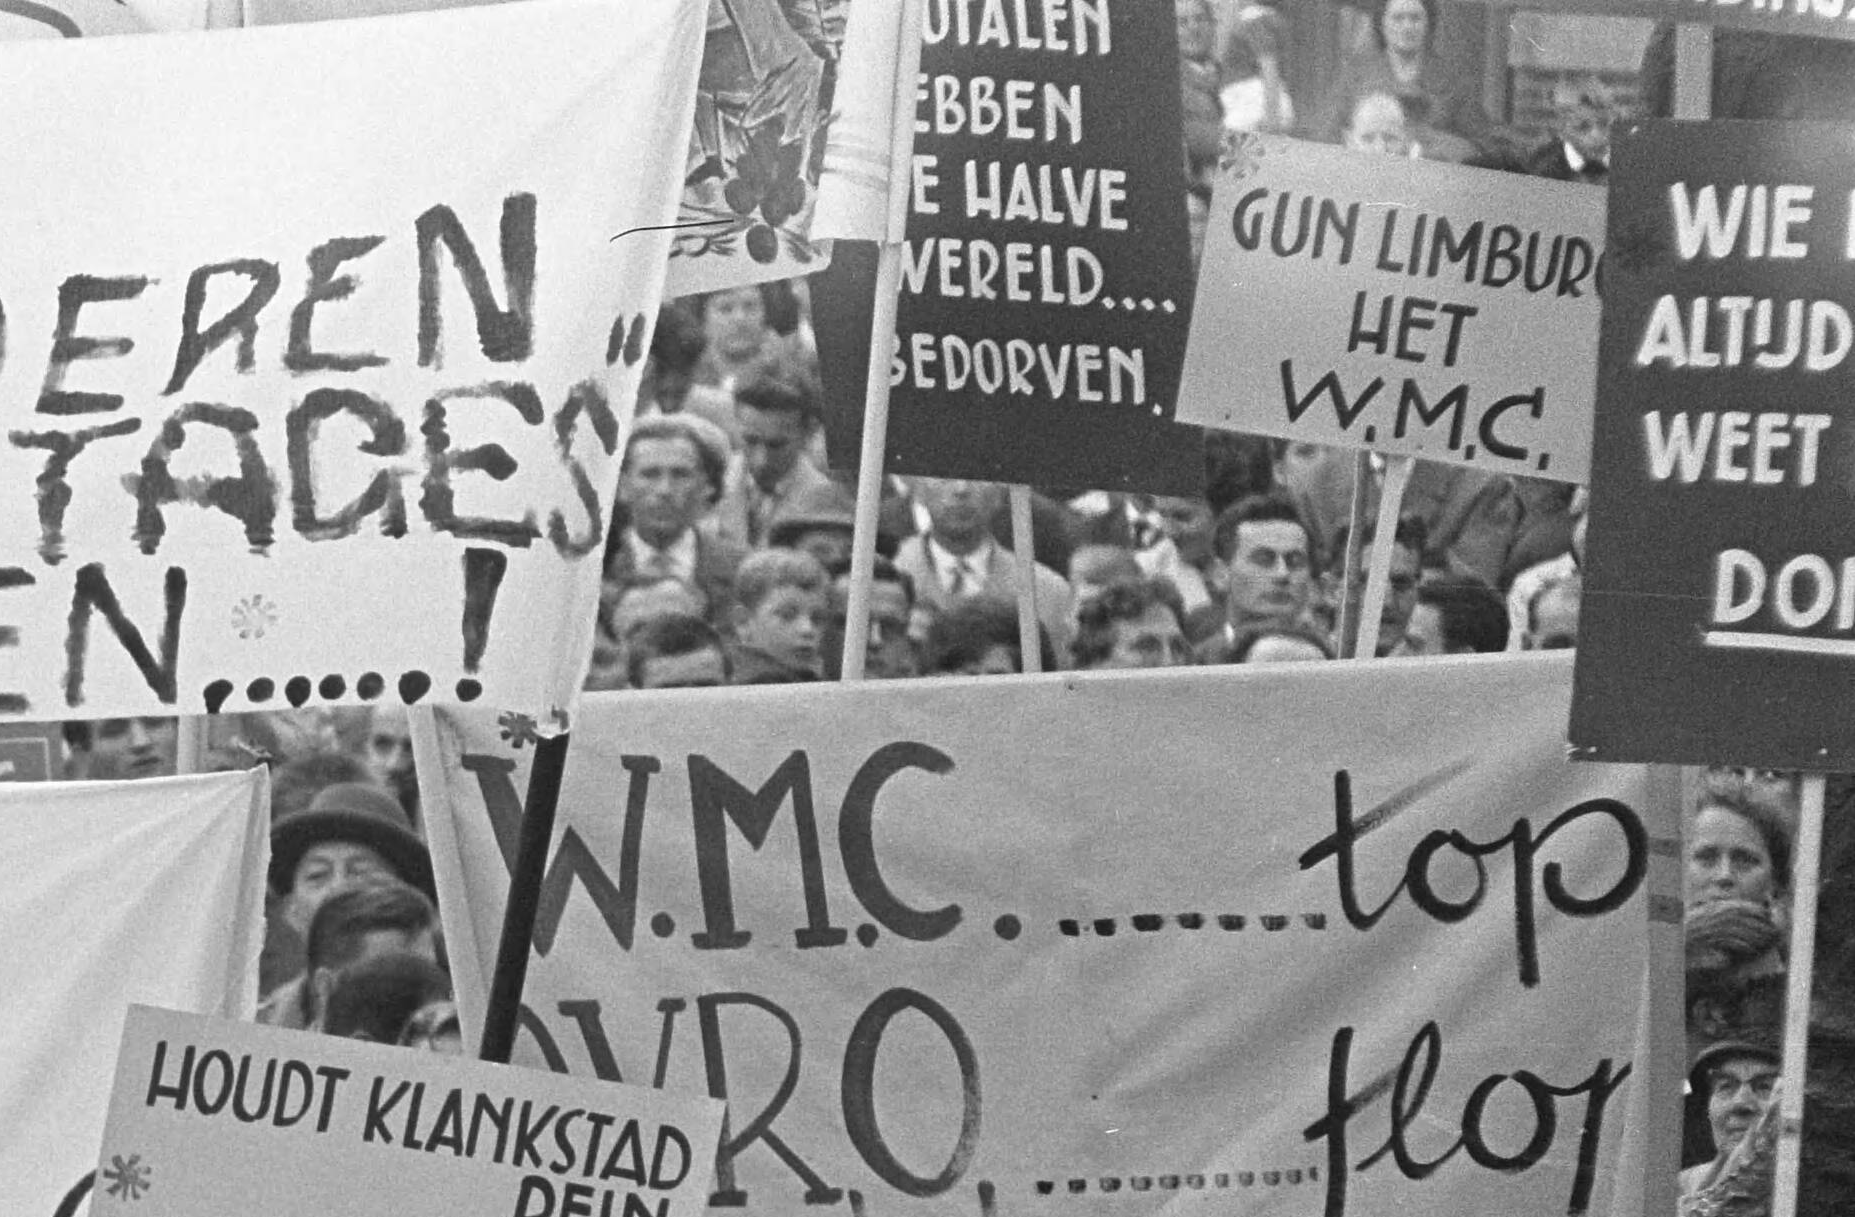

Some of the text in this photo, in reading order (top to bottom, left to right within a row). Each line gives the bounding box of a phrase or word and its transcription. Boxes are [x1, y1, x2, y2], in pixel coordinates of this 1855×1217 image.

[919, 0, 1112, 56] UTALEN
[915, 72, 1082, 144] EBBEN
[910, 153, 1129, 231] E HALVE
[1668, 181, 1815, 261] WIE
[1232, 186, 1604, 299] GUN LIMBUR
[1346, 289, 1480, 368] HET
[1636, 293, 1854, 373] ALTIJD
[1279, 358, 1551, 471] W.M.C.
[1642, 410, 1834, 488] WEET
[146, 1040, 693, 1191] HOUDT KLANKSTAD
